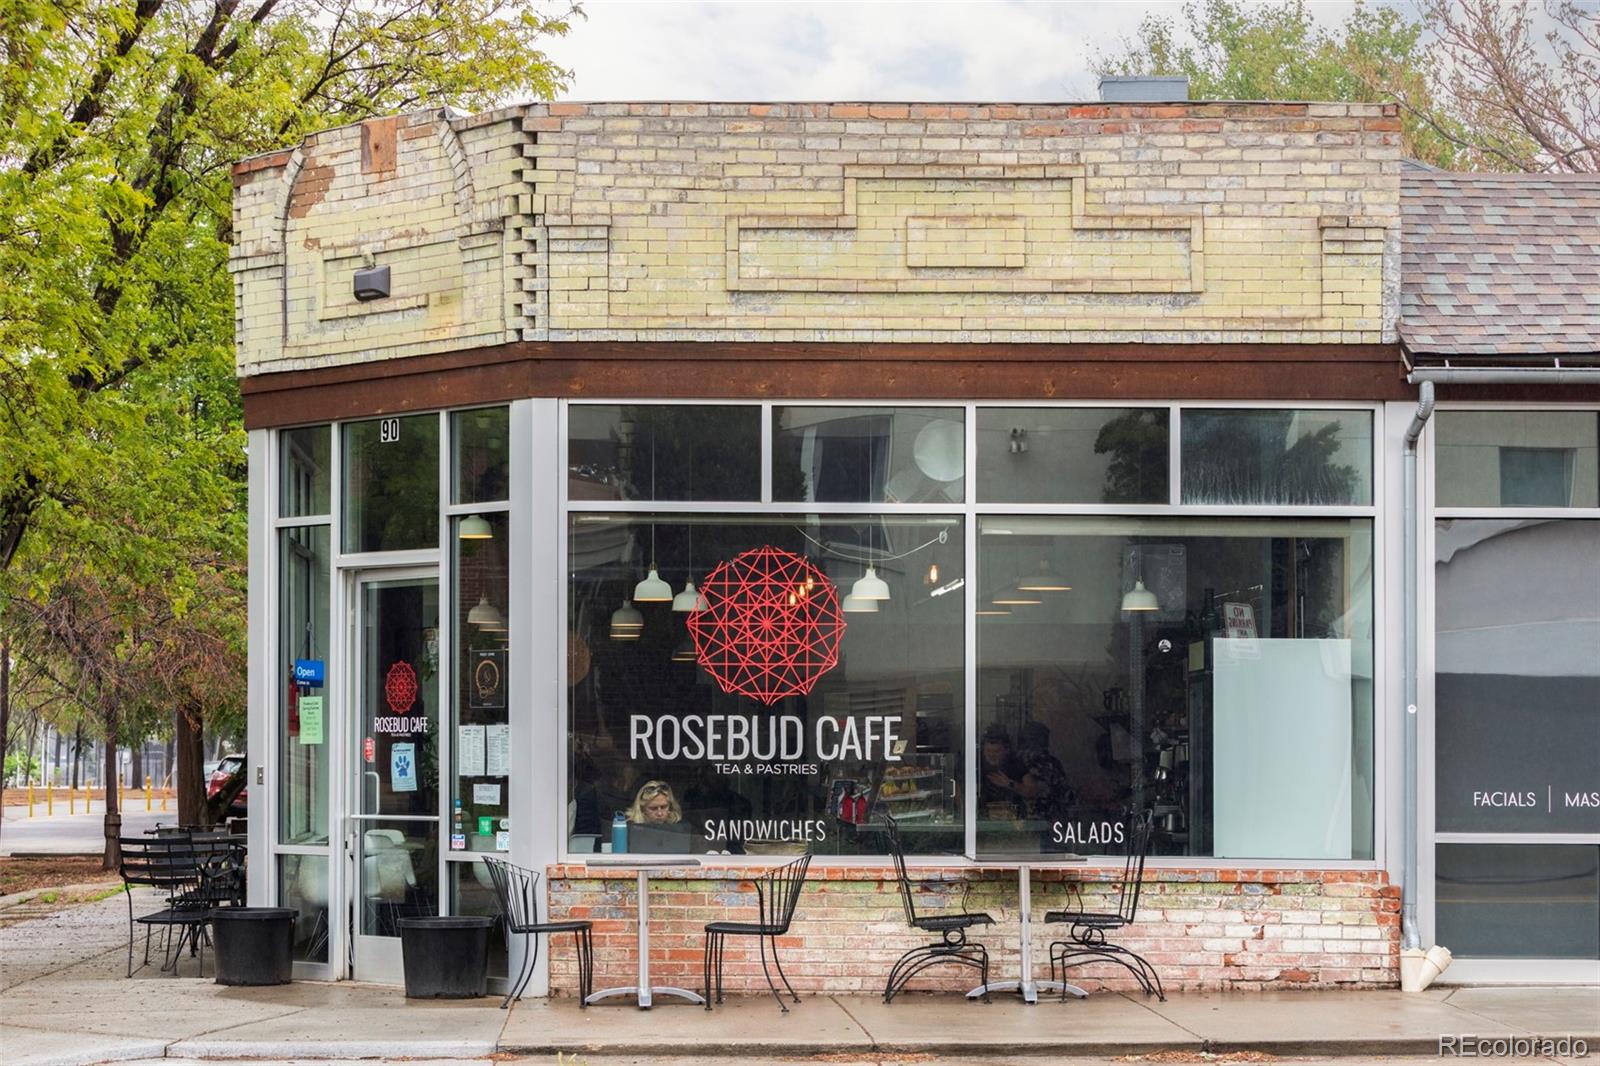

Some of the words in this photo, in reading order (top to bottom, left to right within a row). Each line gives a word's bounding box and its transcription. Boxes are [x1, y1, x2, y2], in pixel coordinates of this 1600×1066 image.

[382, 420, 398, 441] 90
[296, 666, 315, 678] Open
[374, 716, 409, 733] ROSEBUD
[410, 716, 428, 733] CAFE
[630, 714, 804, 762] ROSEBUD
[816, 715, 902, 762] CAFE
[714, 763, 741, 775] TEA
[744, 763, 754, 775] &
[756, 763, 818, 775] PASTRIES
[1472, 791, 1537, 808] FACIALS
[1565, 791, 1600, 808] MAS
[704, 819, 827, 842] SANDWICHES
[1052, 821, 1125, 844] SALADS
